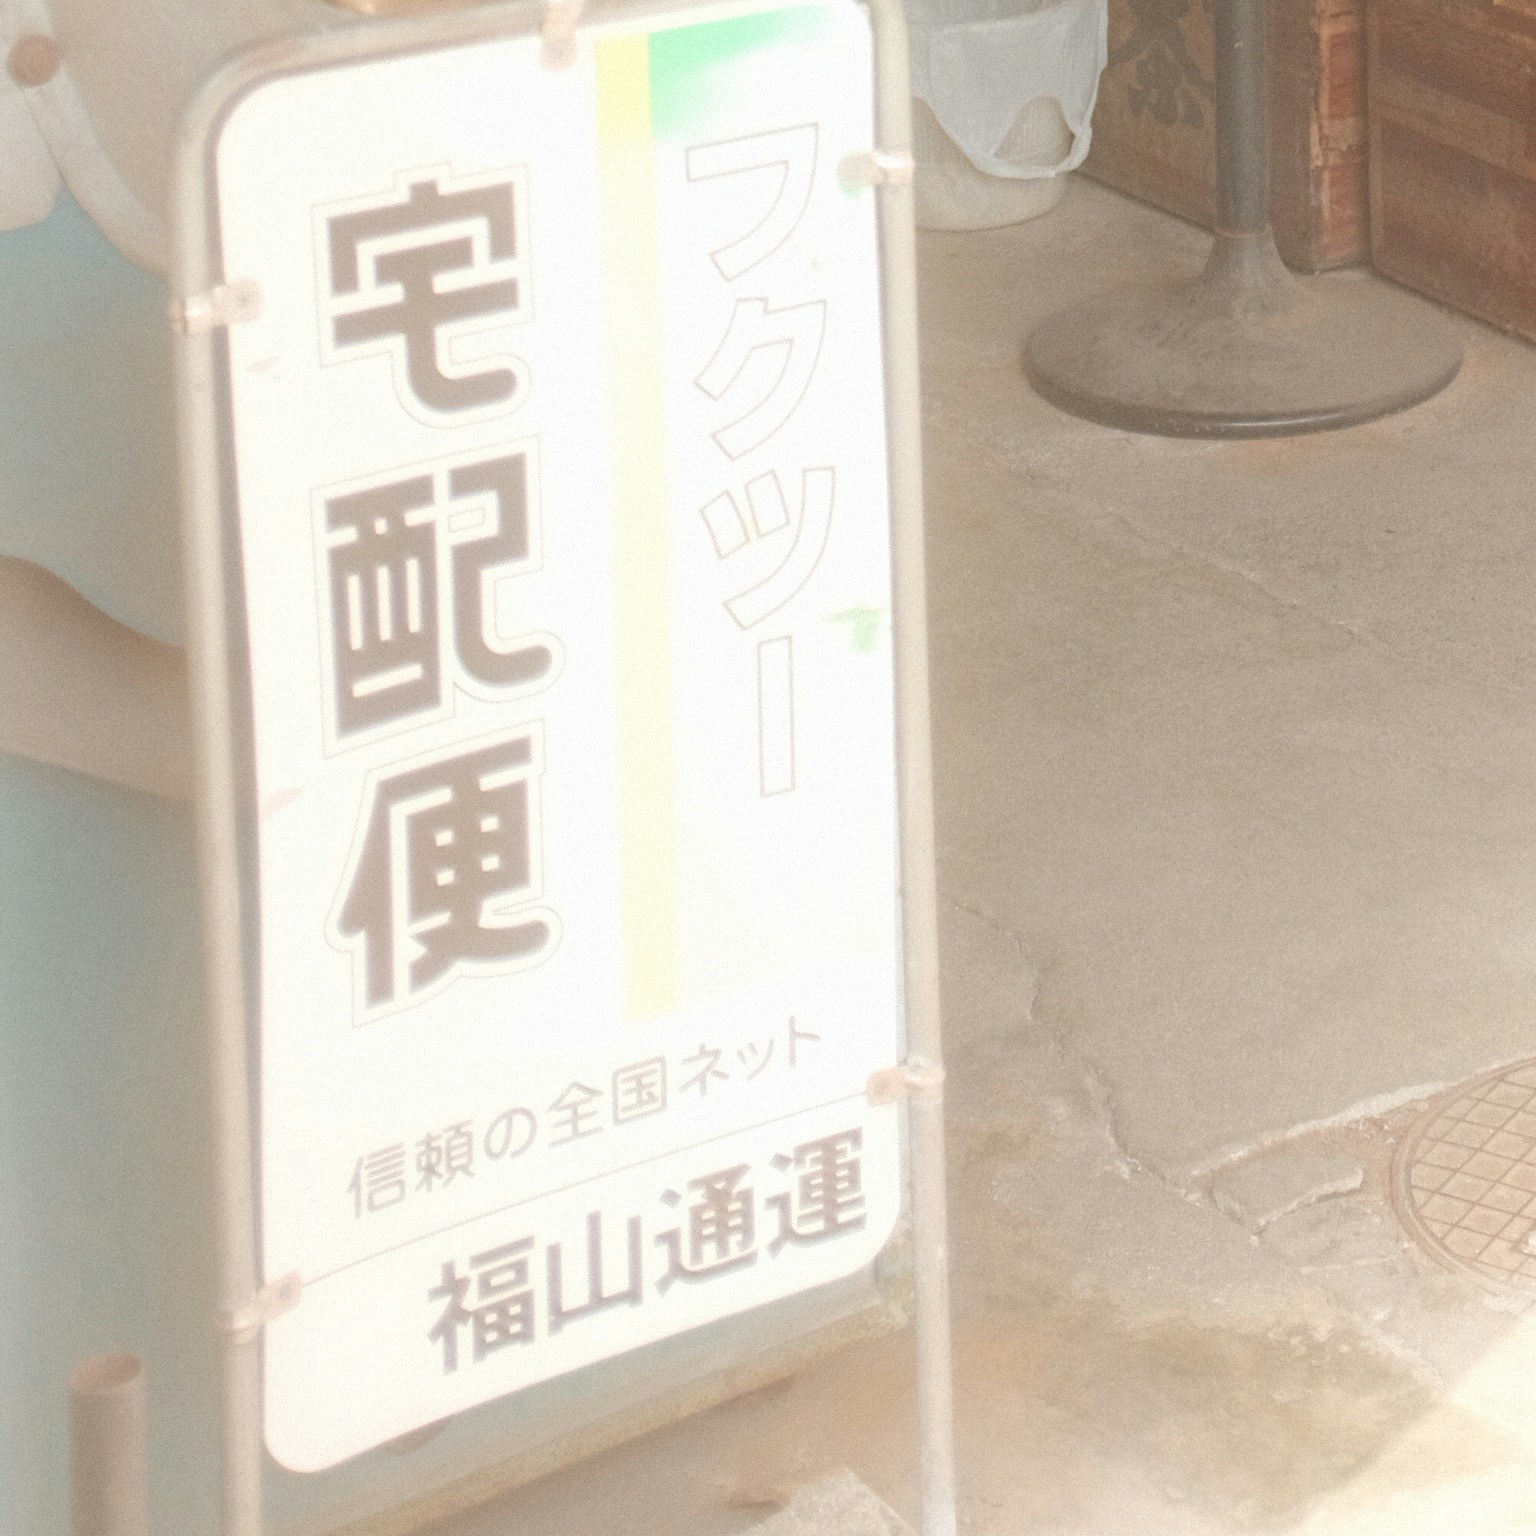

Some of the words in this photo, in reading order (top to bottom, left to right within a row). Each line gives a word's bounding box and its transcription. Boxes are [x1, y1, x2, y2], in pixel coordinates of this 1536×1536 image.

[328, 179, 554, 1008] 宅配便
[685, 119, 837, 797] フクツー
[347, 1015, 823, 1218] 信頼の全国ネット
[425, 1128, 868, 1375] 福山通運
